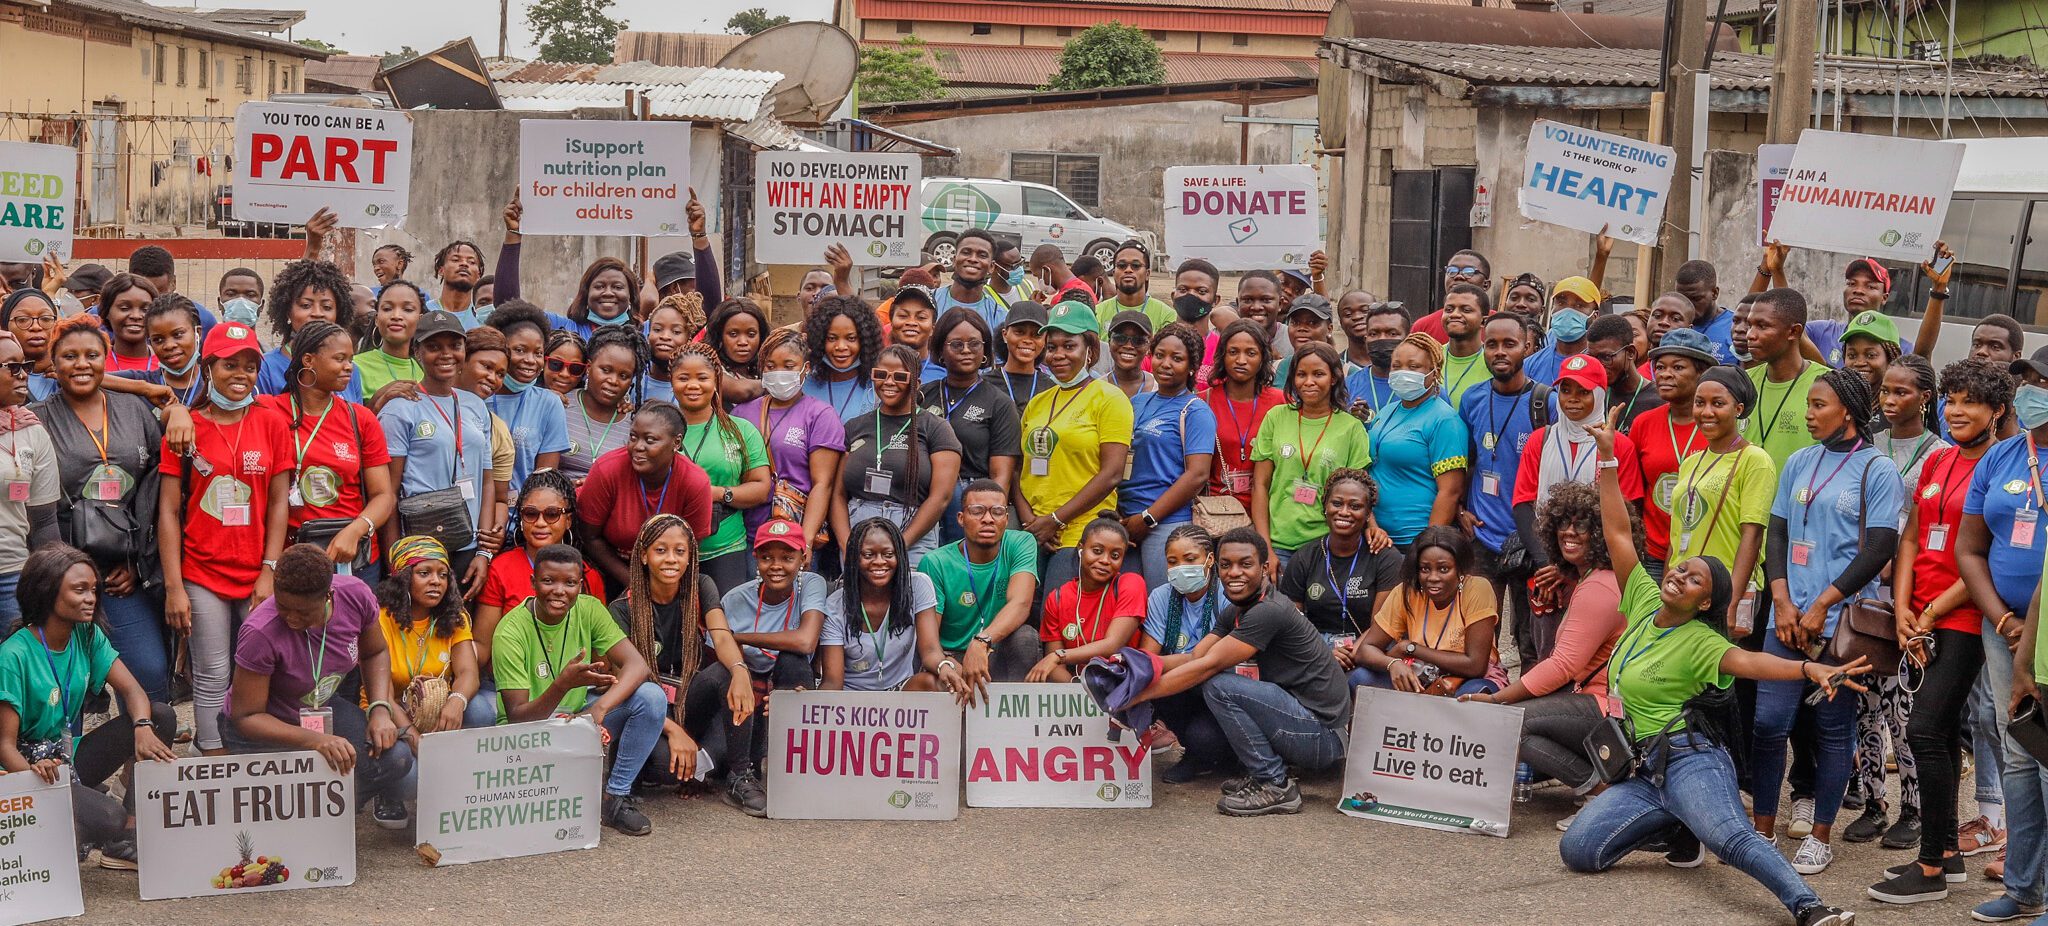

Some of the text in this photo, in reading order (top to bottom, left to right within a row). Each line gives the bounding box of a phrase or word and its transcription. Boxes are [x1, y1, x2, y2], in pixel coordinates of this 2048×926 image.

[263, 112, 385, 131] YOU TOO CAN BE A
[250, 133, 398, 184] PART
[566, 138, 644, 159] iSupport
[1545, 125, 1668, 168] VOLUNTEERING
[543, 160, 666, 181] nutrition plan
[771, 161, 909, 181] NO DEVELOPMENT
[1562, 150, 1638, 174] IS THE WORK OF
[0, 171, 64, 200] EED
[1183, 177, 1247, 187] SAVE A LIFE:
[1788, 168, 1827, 182] I AM A
[532, 181, 676, 199] for children and
[766, 181, 912, 210] WITH AN EMPTY
[1529, 162, 1659, 216] HEART
[1781, 183, 1936, 216] HUMANITARIAN
[575, 203, 633, 220] adults
[1182, 190, 1307, 216] DONATE
[0, 201, 65, 230] ARE
[772, 211, 904, 238] STOMACH
[802, 704, 929, 729] LET'S KICK OUT
[997, 694, 1030, 718] AM
[1038, 694, 1104, 718] HUNG
[476, 731, 552, 754] HUNGER
[1034, 724, 1083, 737] I AM
[785, 728, 940, 780] HUNGER
[1382, 726, 1487, 760] Eat to live
[177, 757, 314, 782] KEEP CALM
[506, 754, 522, 764] IS A
[968, 746, 1148, 782] ANGRY
[1372, 751, 1488, 788] Live to eat.
[472, 763, 556, 790] THREAT
[0, 795, 34, 814] GER
[232, 779, 346, 824] FRUITS
[465, 786, 559, 805] TO HUMAN SECURITY
[0, 812, 37, 830] sible
[439, 796, 583, 835] EVERYWHERE
[1378, 806, 1402, 816] Happy
[1404, 810, 1428, 819] World
[1449, 816, 1465, 825] Day
[0, 831, 16, 846] of
[0, 855, 22, 871] bal
[0, 869, 51, 886] anking
